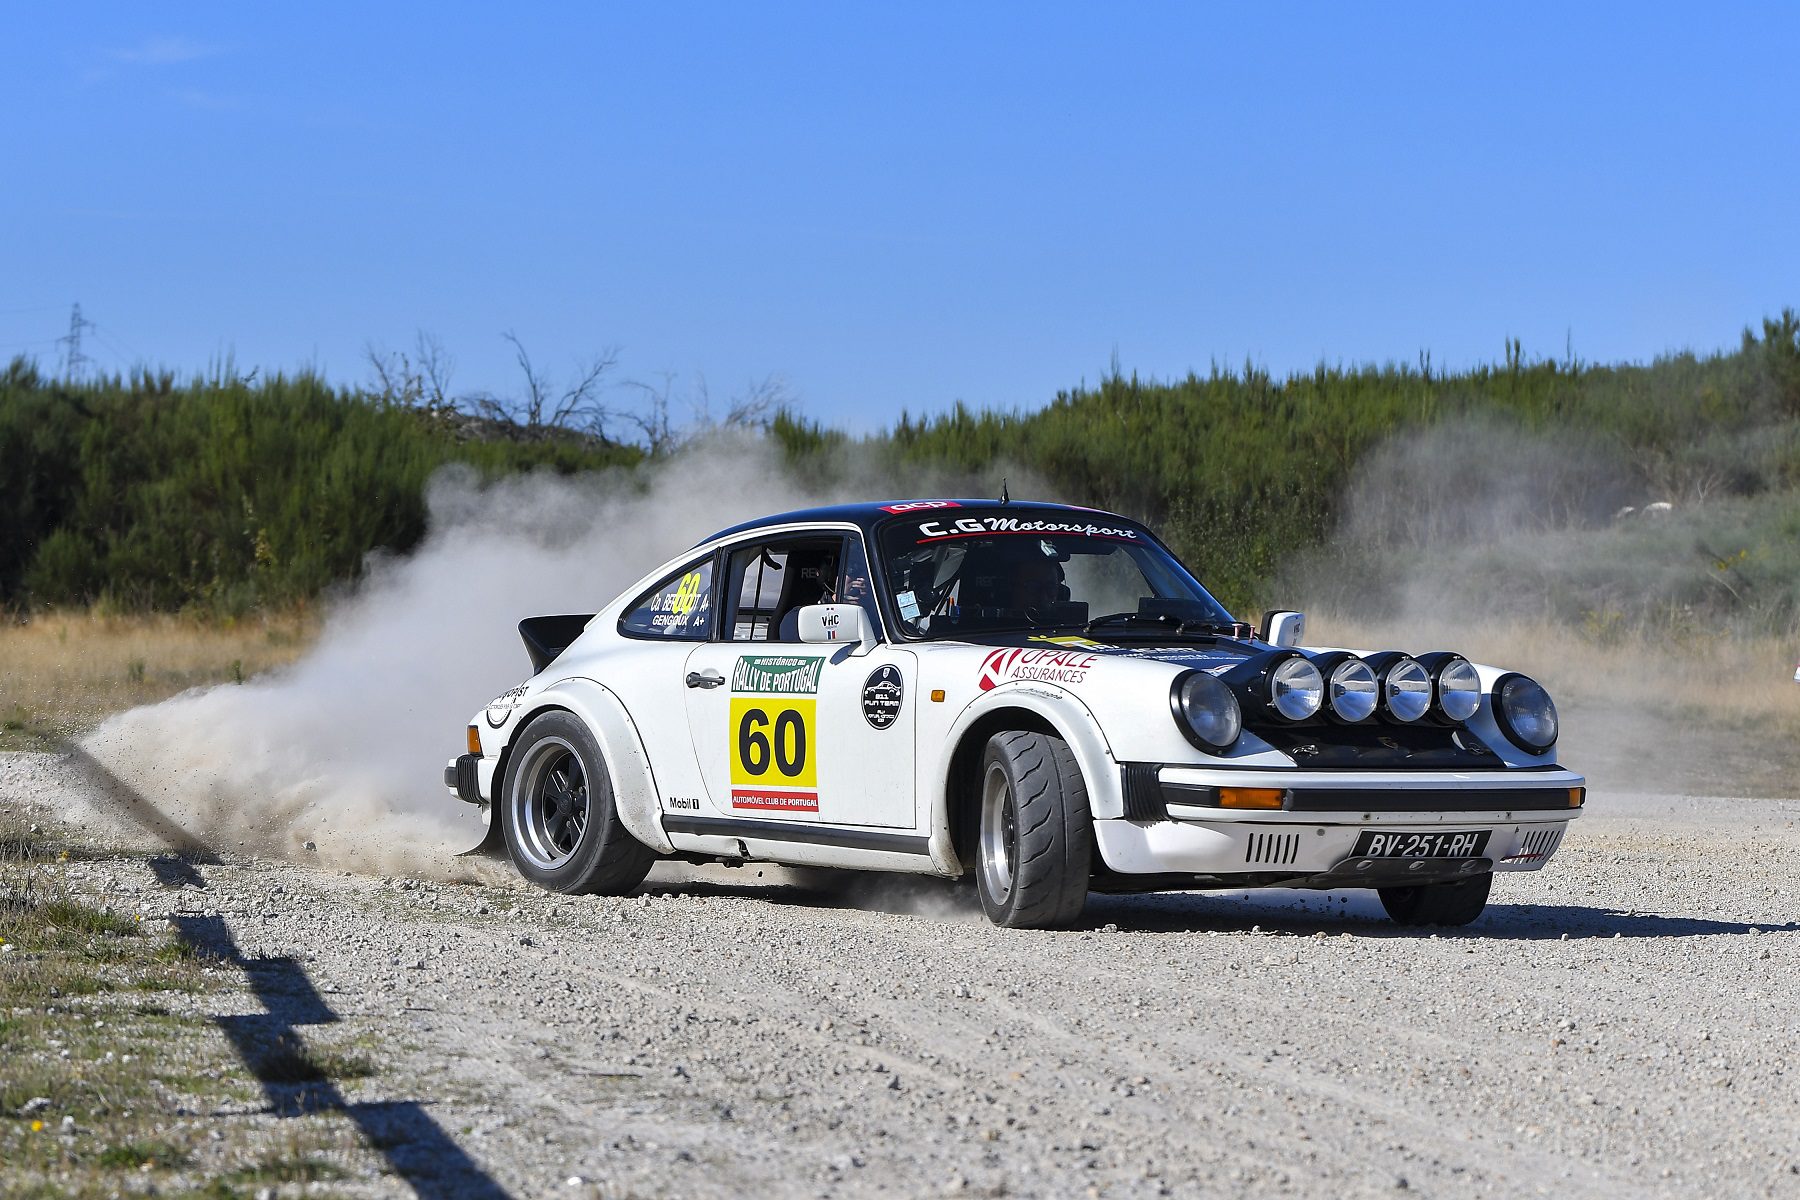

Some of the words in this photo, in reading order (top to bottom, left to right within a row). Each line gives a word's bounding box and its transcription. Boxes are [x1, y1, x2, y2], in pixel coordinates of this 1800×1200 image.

[984, 518, 1136, 539] Motorsport
[672, 572, 701, 614] 60
[652, 614, 689, 626] GENGOUX
[692, 615, 705, 627] A+
[821, 614, 839, 627] VHC
[760, 656, 799, 667] HISTÓRICO
[1021, 649, 1101, 669] OPALE
[732, 656, 760, 692] RALLY
[760, 671, 772, 692] DE
[772, 657, 822, 693] PORTUGAL
[1011, 665, 1087, 684] ASSURANCES
[738, 708, 807, 778] 60
[669, 796, 692, 810] Mobil
[732, 795, 765, 805] AUTOMÓVEL
[765, 797, 779, 805] CLUB
[780, 798, 788, 806] DE
[788, 798, 818, 807] PORTUGAL
[1366, 833, 1479, 857] BV-251-RH
